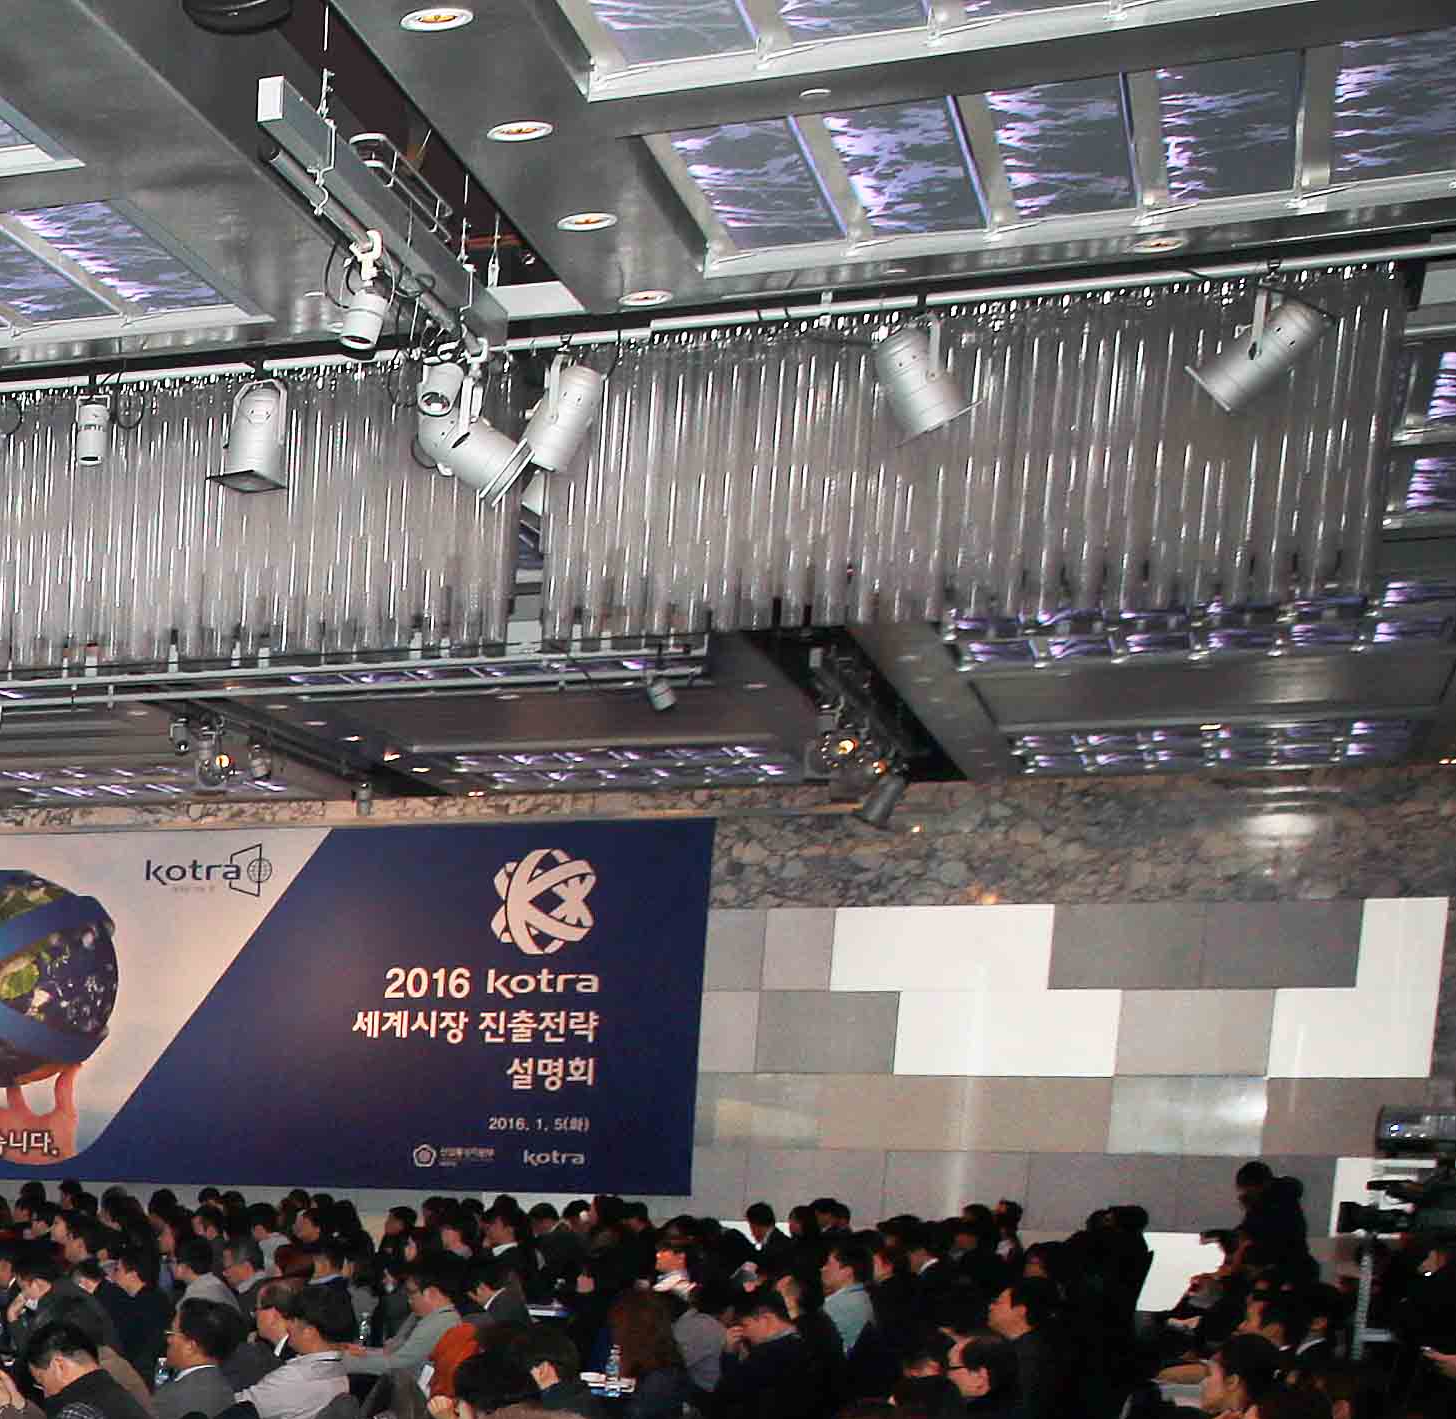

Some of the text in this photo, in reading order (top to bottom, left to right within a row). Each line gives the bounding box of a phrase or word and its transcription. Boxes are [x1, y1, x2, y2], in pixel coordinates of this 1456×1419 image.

[145, 860, 241, 886] kotra
[384, 967, 599, 999] 2016 kotra
[352, 1010, 599, 1044] 세계시장 진출전략
[506, 1057, 595, 1091] 설명회
[488, 1116, 531, 1131] 2016.
[523, 1149, 586, 1166] kotra
